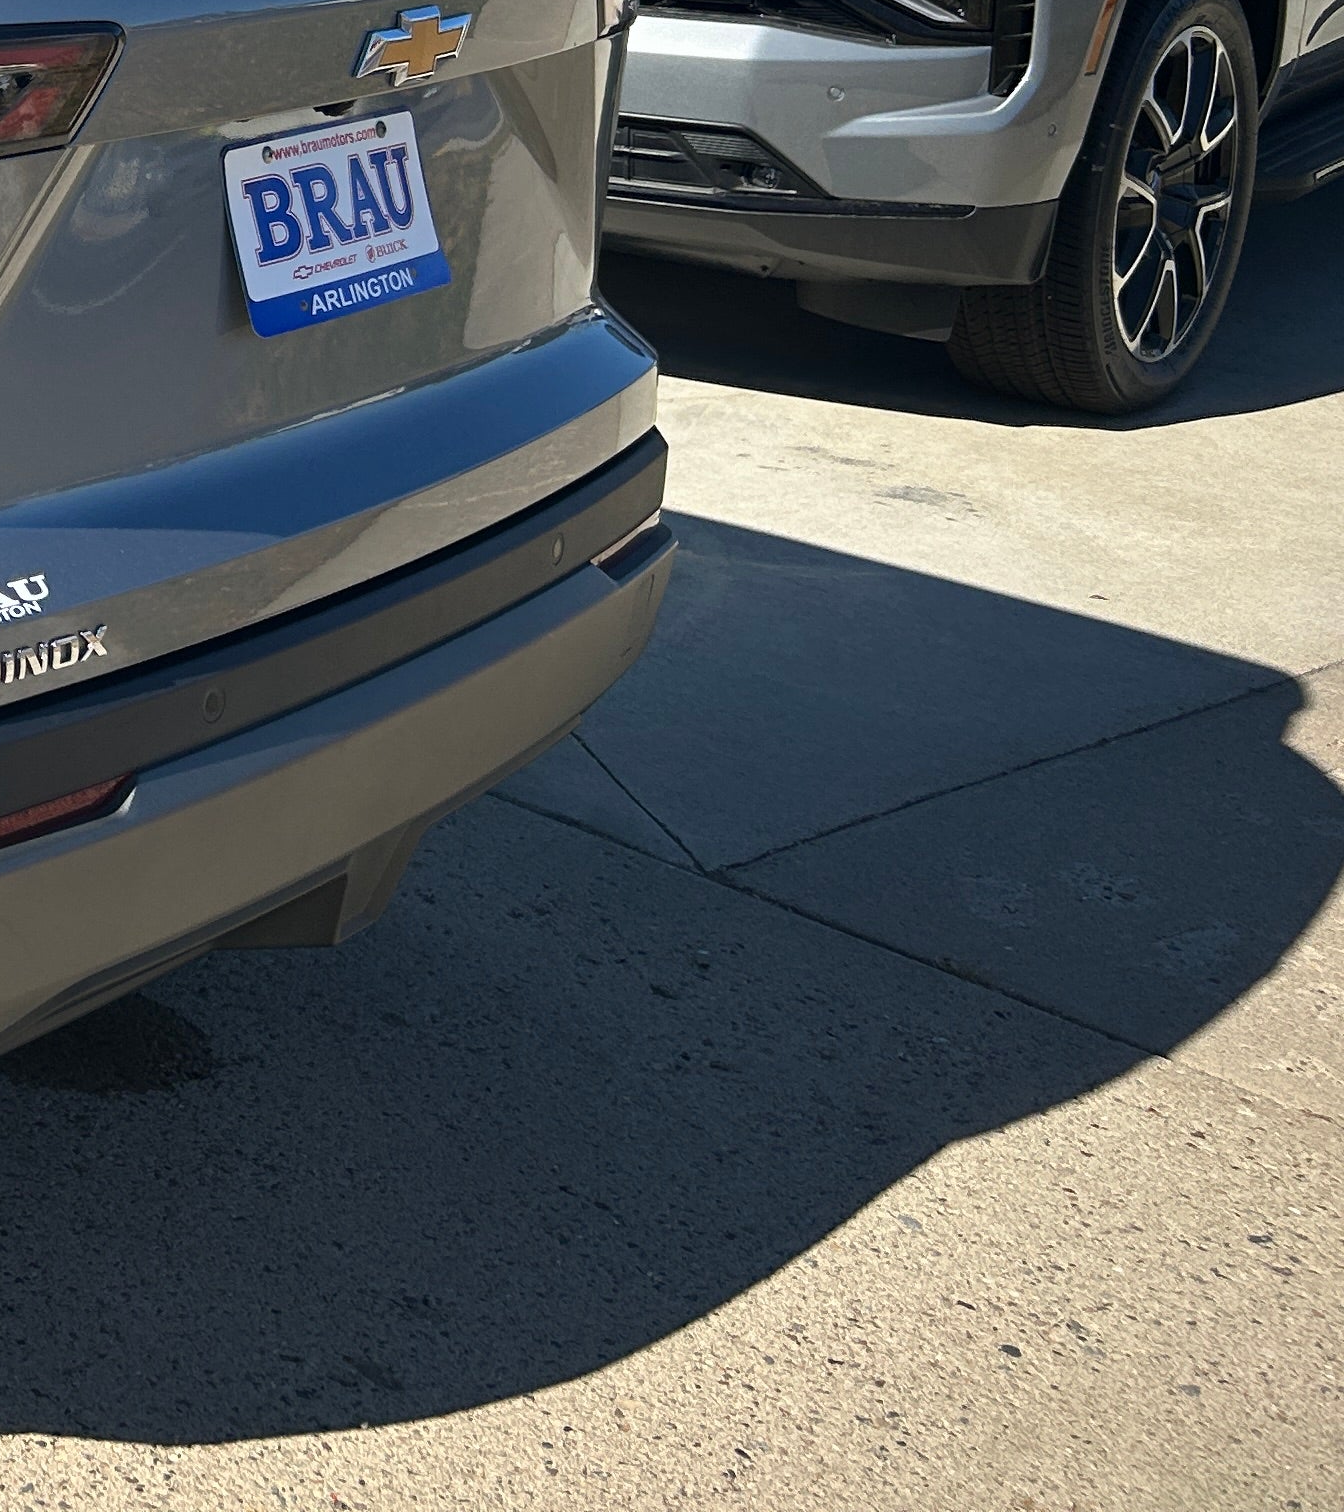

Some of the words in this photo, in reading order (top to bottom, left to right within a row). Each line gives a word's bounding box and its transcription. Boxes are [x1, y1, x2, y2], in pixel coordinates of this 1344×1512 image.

[272, 126, 377, 161] www.braumotors.com
[240, 142, 415, 268] BRAU
[314, 253, 358, 274] CHEVROLET
[376, 239, 408, 259] BUICK
[312, 267, 415, 316] ARLINGTON
